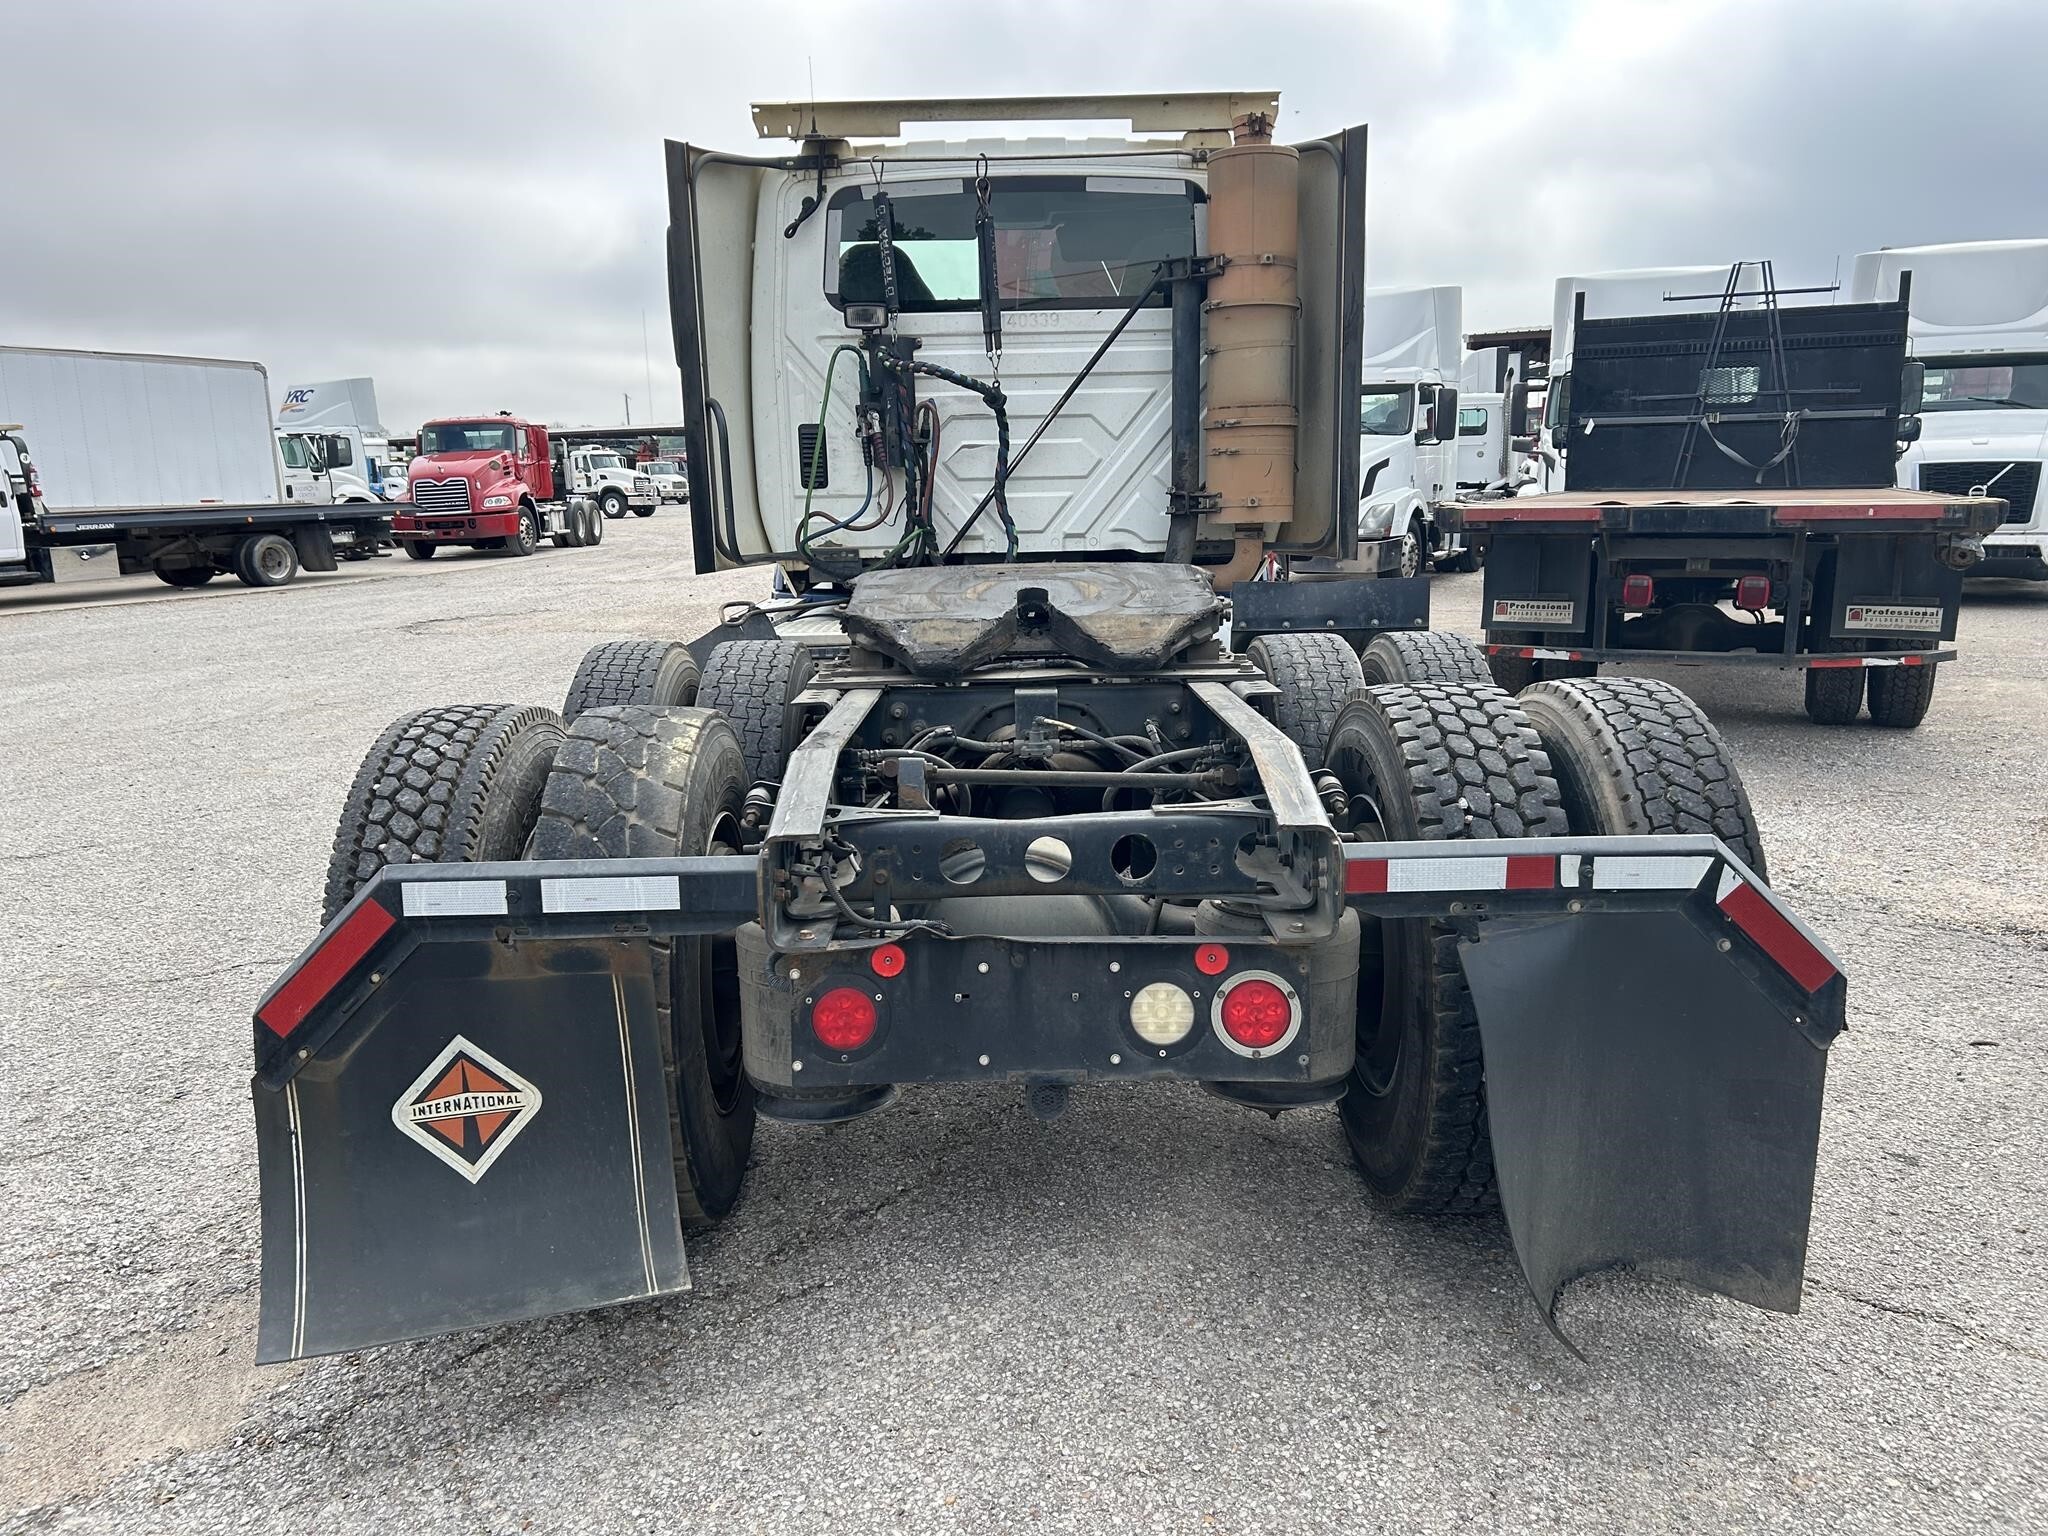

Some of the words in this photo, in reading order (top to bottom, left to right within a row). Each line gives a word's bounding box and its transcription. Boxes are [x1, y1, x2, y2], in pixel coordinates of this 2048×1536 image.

[1008, 312, 1059, 328] 40339
[285, 389, 314, 403] YRC
[1509, 602, 1571, 610] Professional
[1865, 608, 1939, 617] Professional
[413, 1095, 521, 1117] INTERNATIONAL
